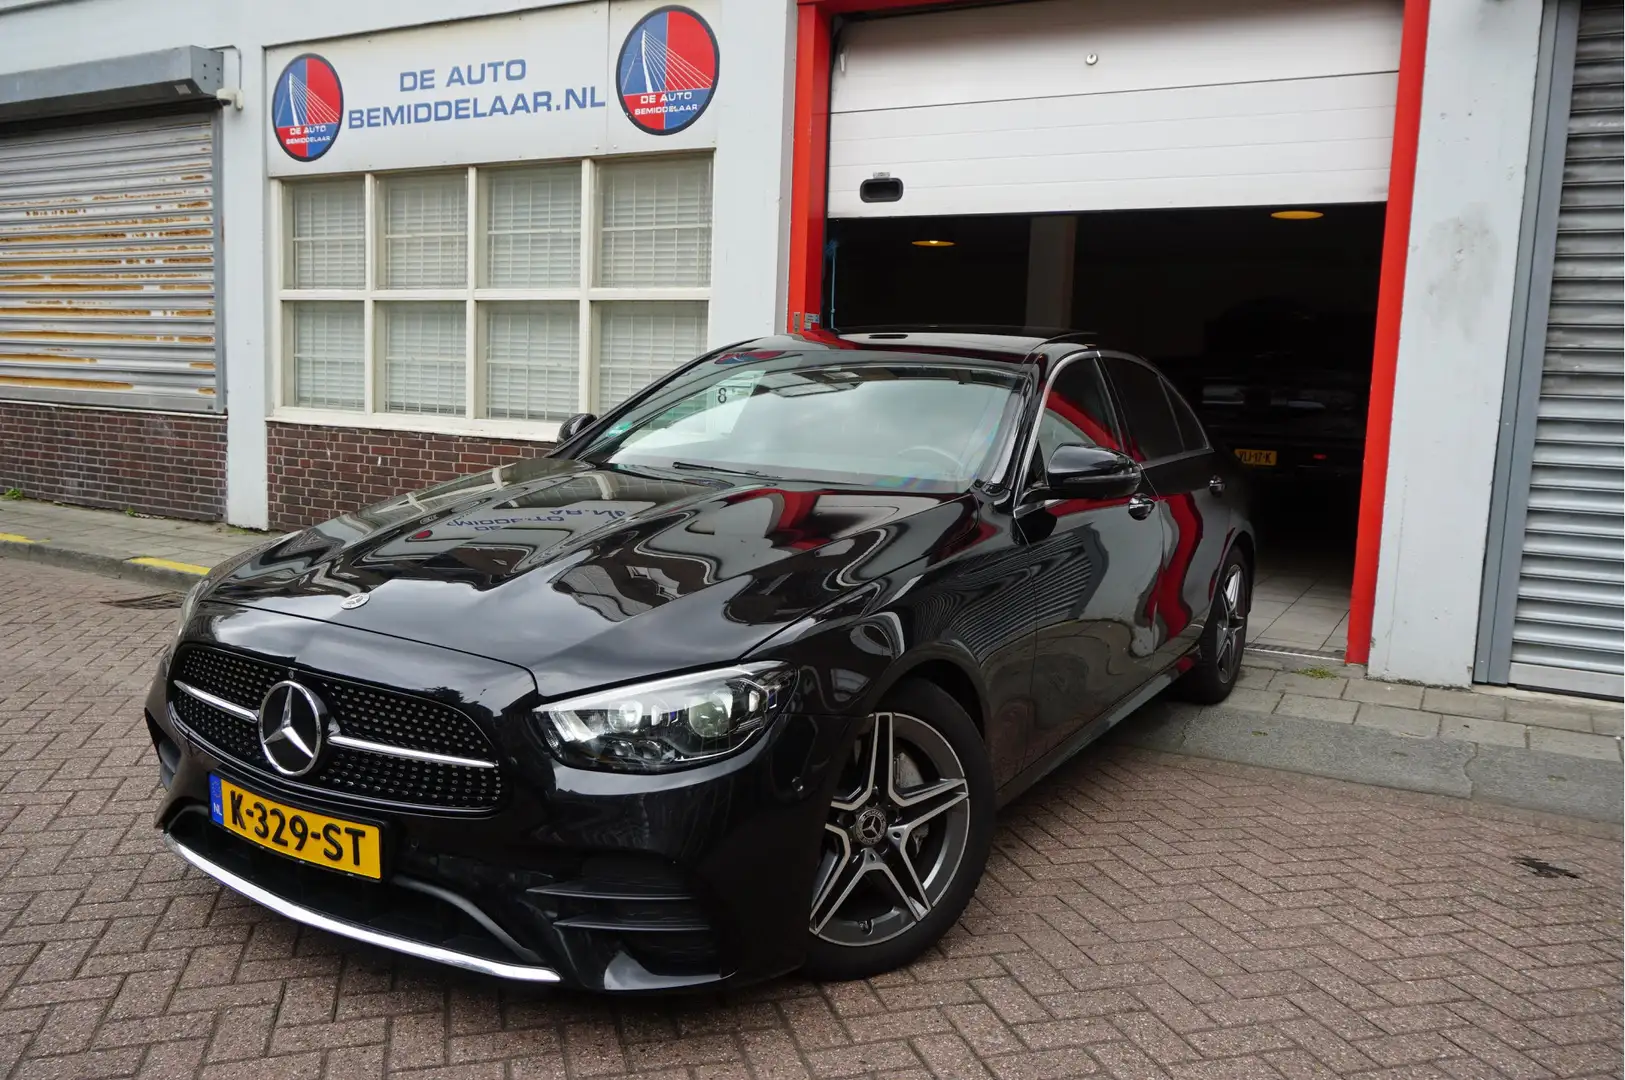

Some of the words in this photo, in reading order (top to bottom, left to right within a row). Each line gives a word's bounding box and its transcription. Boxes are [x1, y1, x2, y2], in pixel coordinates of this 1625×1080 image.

[399, 69, 436, 92] DE
[445, 59, 527, 88] AUTO
[640, 94, 657, 104] DE
[659, 91, 693, 103] AUTO
[348, 86, 606, 129] BEMIDDELAAR.NL
[634, 103, 698, 116] BEMIDDELAAR
[289, 127, 302, 136] DE
[302, 125, 327, 134] AUTO
[285, 135, 331, 145] BEMIDDELAAR
[213, 802, 223, 816] NL
[230, 789, 366, 866] K-329-ST
